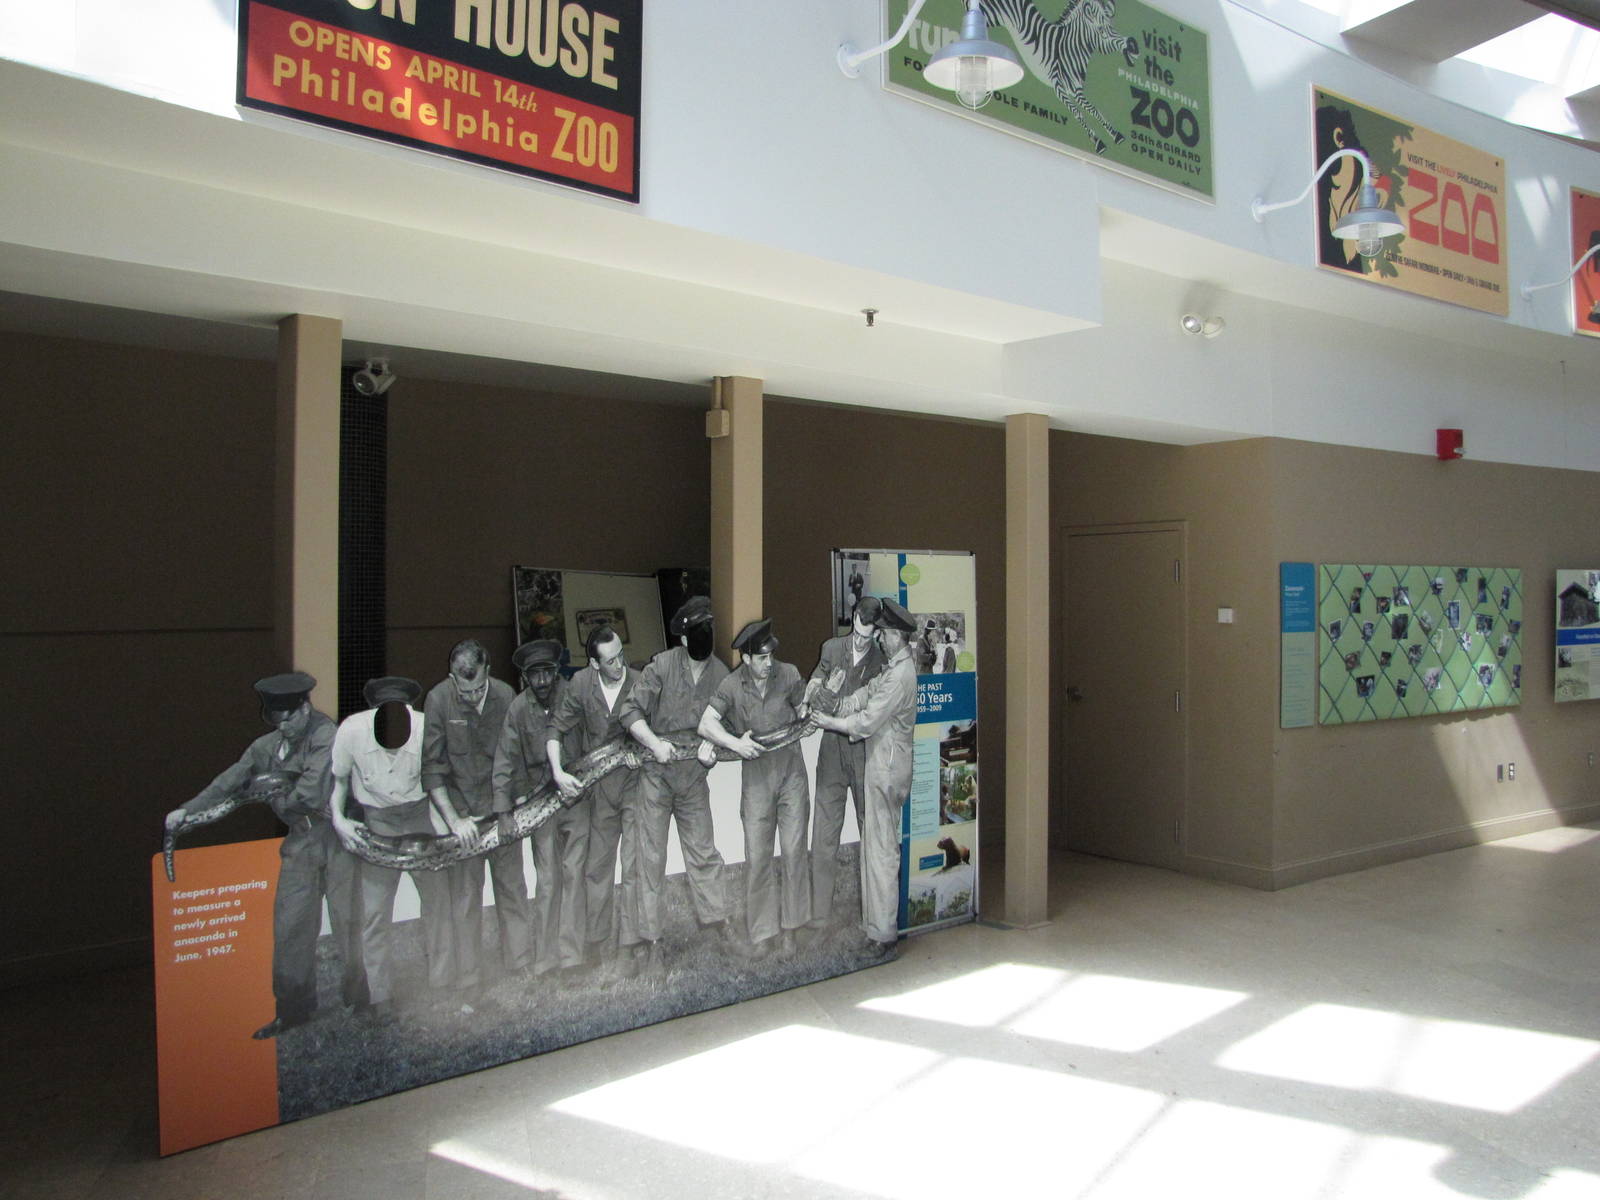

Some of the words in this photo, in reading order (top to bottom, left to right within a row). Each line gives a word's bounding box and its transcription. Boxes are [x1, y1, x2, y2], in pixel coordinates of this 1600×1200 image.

[455, 0, 620, 90] HOUSE
[1142, 28, 1182, 63] visit
[289, 20, 392, 71] OPENS
[405, 55, 481, 98] APRIL
[494, 80, 538, 114] 14th
[1144, 54, 1174, 87] the
[903, 56, 930, 74] FO
[1024, 102, 1069, 126] FAMILY
[1118, 67, 1199, 110] PHILADELPHIA
[273, 54, 539, 154] Philadelphia
[551, 107, 620, 174] ZOO
[1130, 85, 1200, 148] ZOO
[1131, 143, 1164, 163] OPEN
[1168, 157, 1201, 176] DAILY
[1407, 167, 1500, 265] ZOO
[917, 684, 926, 692] HE
[927, 682, 943, 691] PAST
[927, 692, 953, 704] Years
[172, 887, 215, 900] Keepers
[218, 880, 268, 896] preparing
[173, 907, 184, 916] to
[187, 901, 231, 914] measure
[233, 898, 241, 906] a
[173, 918, 207, 931] newly
[208, 911, 247, 925] arrived
[174, 931, 226, 947] anaconda
[228, 929, 238, 938] in
[174, 949, 202, 963] June,
[206, 944, 236, 957] 1947.
